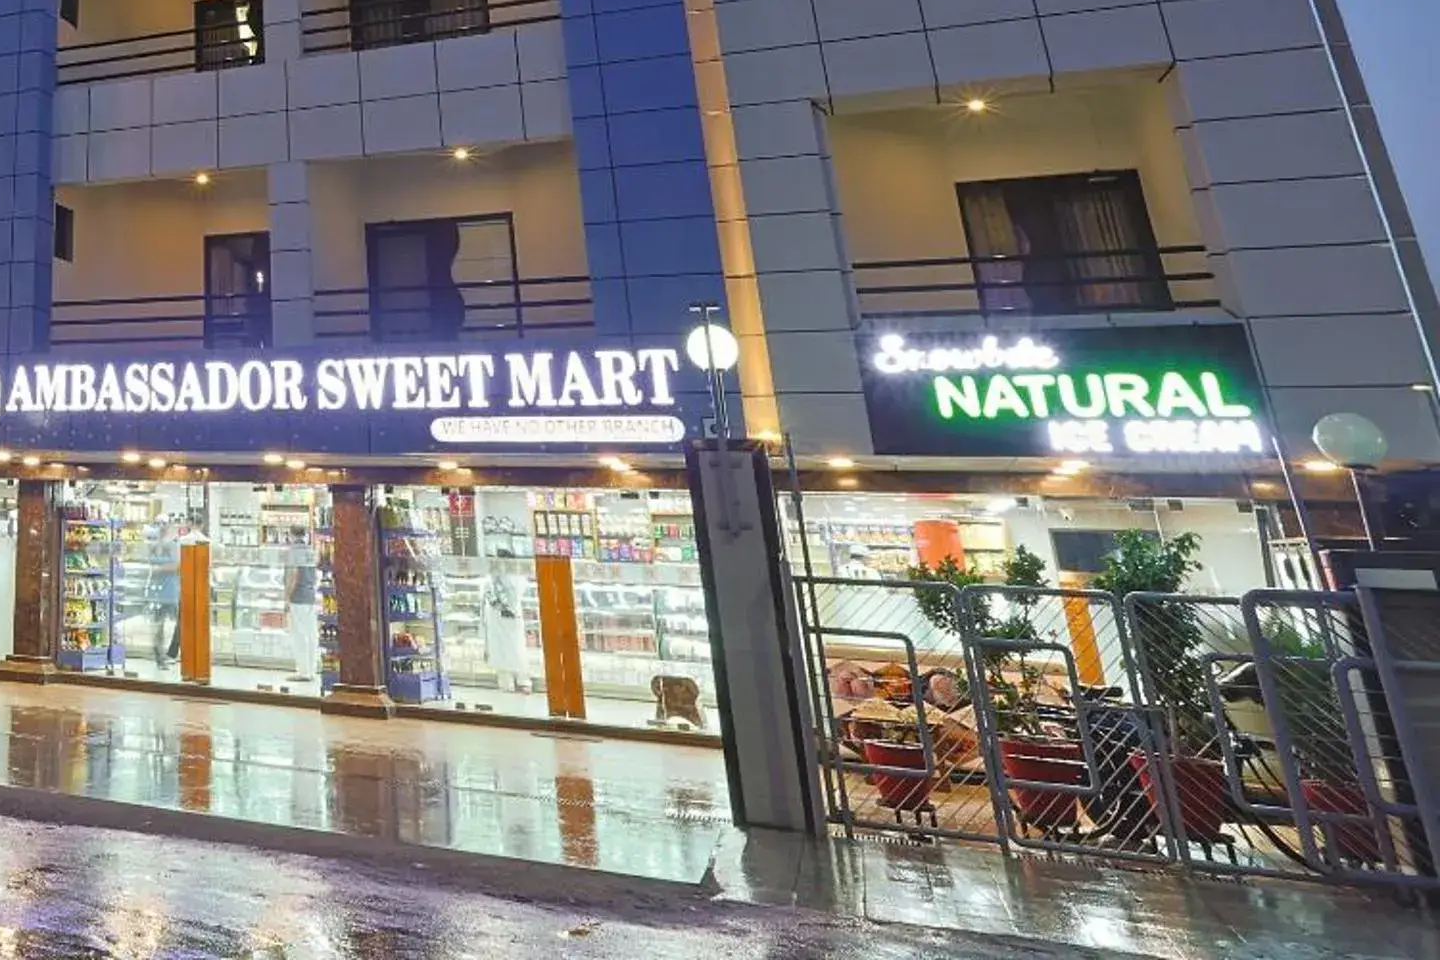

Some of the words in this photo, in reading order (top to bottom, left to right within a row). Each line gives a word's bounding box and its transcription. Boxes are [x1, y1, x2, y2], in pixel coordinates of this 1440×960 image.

[5, 359, 307, 412] AMBASSADOR
[317, 354, 494, 410] SWEET
[505, 348, 679, 406] MART
[933, 371, 1251, 419] NATURAL
[442, 420, 465, 435] WE
[545, 420, 595, 435] OTHER
